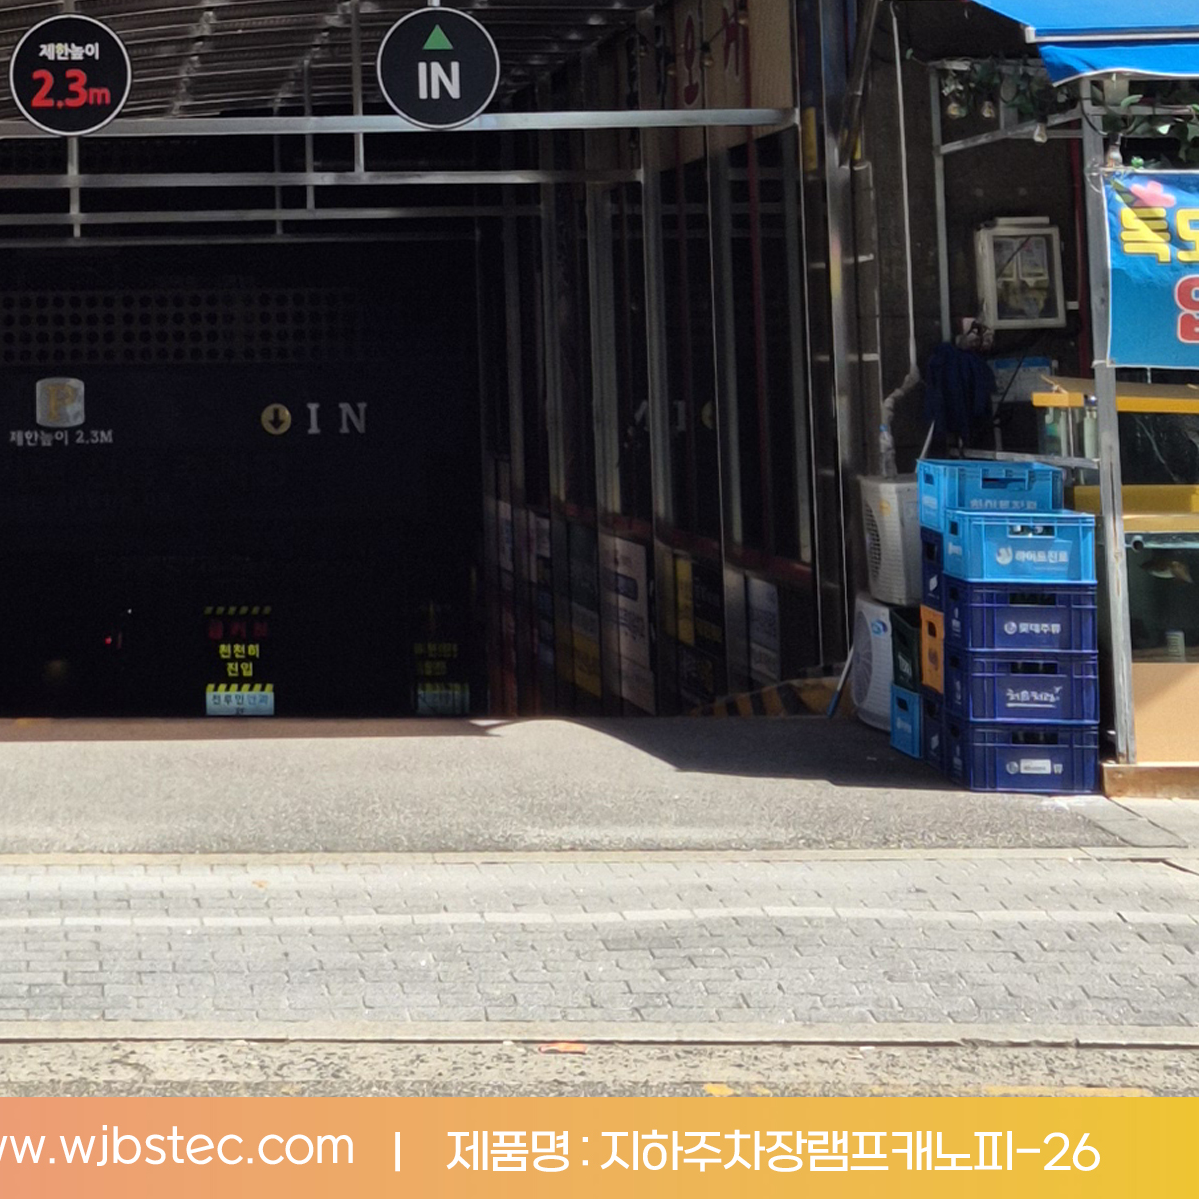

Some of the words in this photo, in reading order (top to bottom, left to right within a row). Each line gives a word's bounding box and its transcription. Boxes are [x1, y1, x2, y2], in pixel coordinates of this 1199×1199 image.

[39, 42, 101, 61] 제한높이
[31, 69, 111, 111] 2.3m
[418, 61, 461, 101] IN
[75, 431, 114, 445] 2.3M
